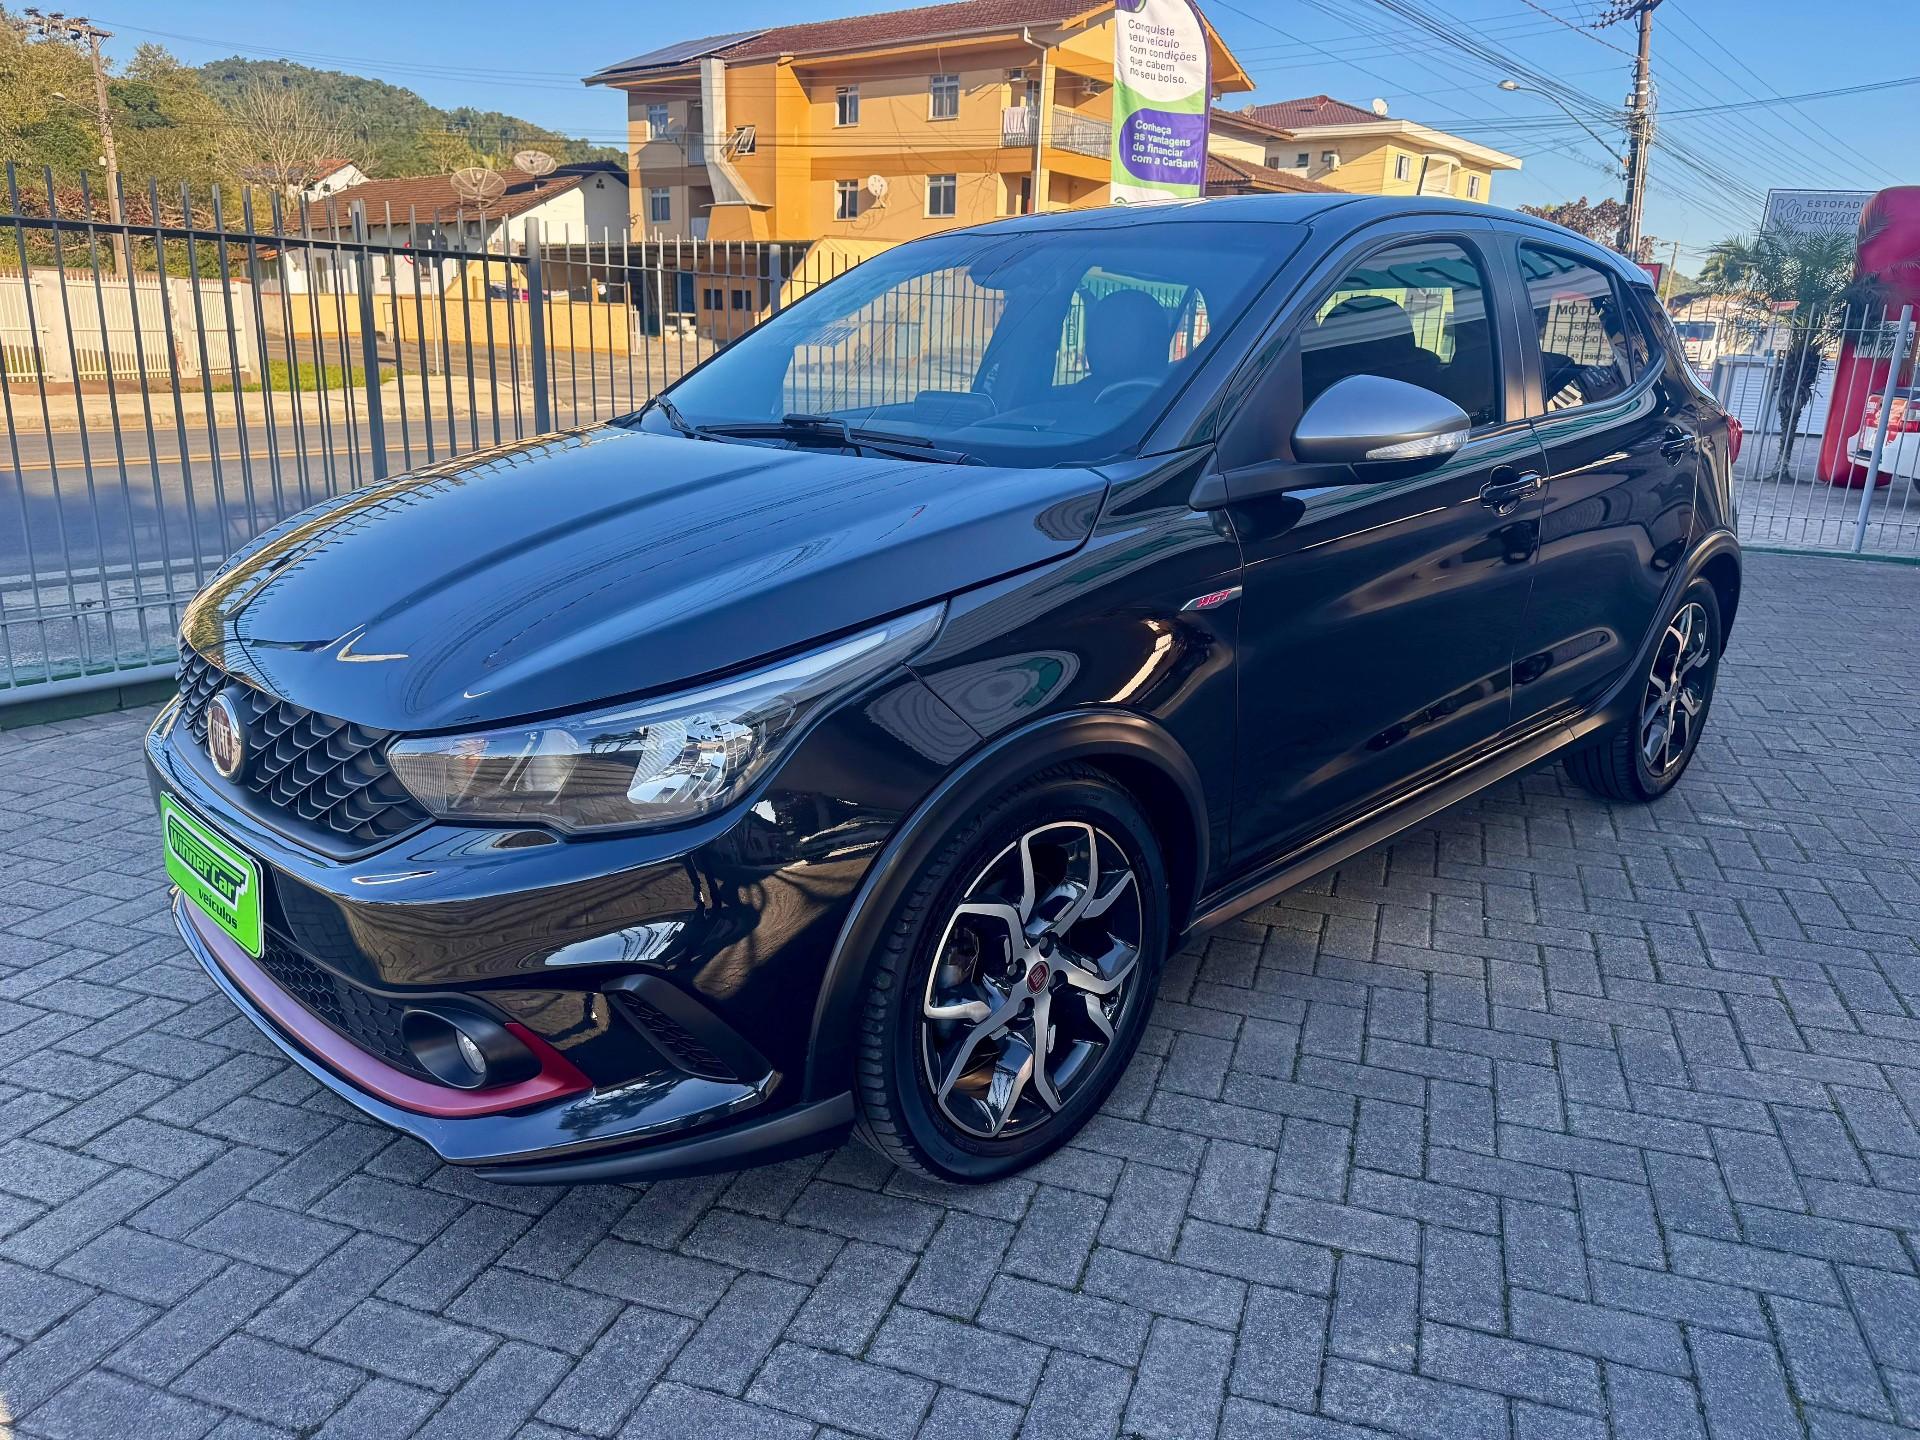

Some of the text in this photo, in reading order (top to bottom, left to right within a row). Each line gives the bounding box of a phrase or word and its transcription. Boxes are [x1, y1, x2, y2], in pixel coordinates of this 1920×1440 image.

[1128, 19, 1175, 37] Conquiste
[1129, 33, 1180, 49] seu veículo
[1129, 44, 1197, 63] com condições
[1130, 56, 1175, 72] que cabem
[1129, 67, 1188, 85] no seu bolso.
[1135, 119, 1172, 137] Conheça
[1133, 132, 1191, 148] as vantagens
[1132, 142, 1184, 157] de financiar
[1131, 154, 1199, 169] com a CarBank
[170, 827, 236, 899] Winner Car
